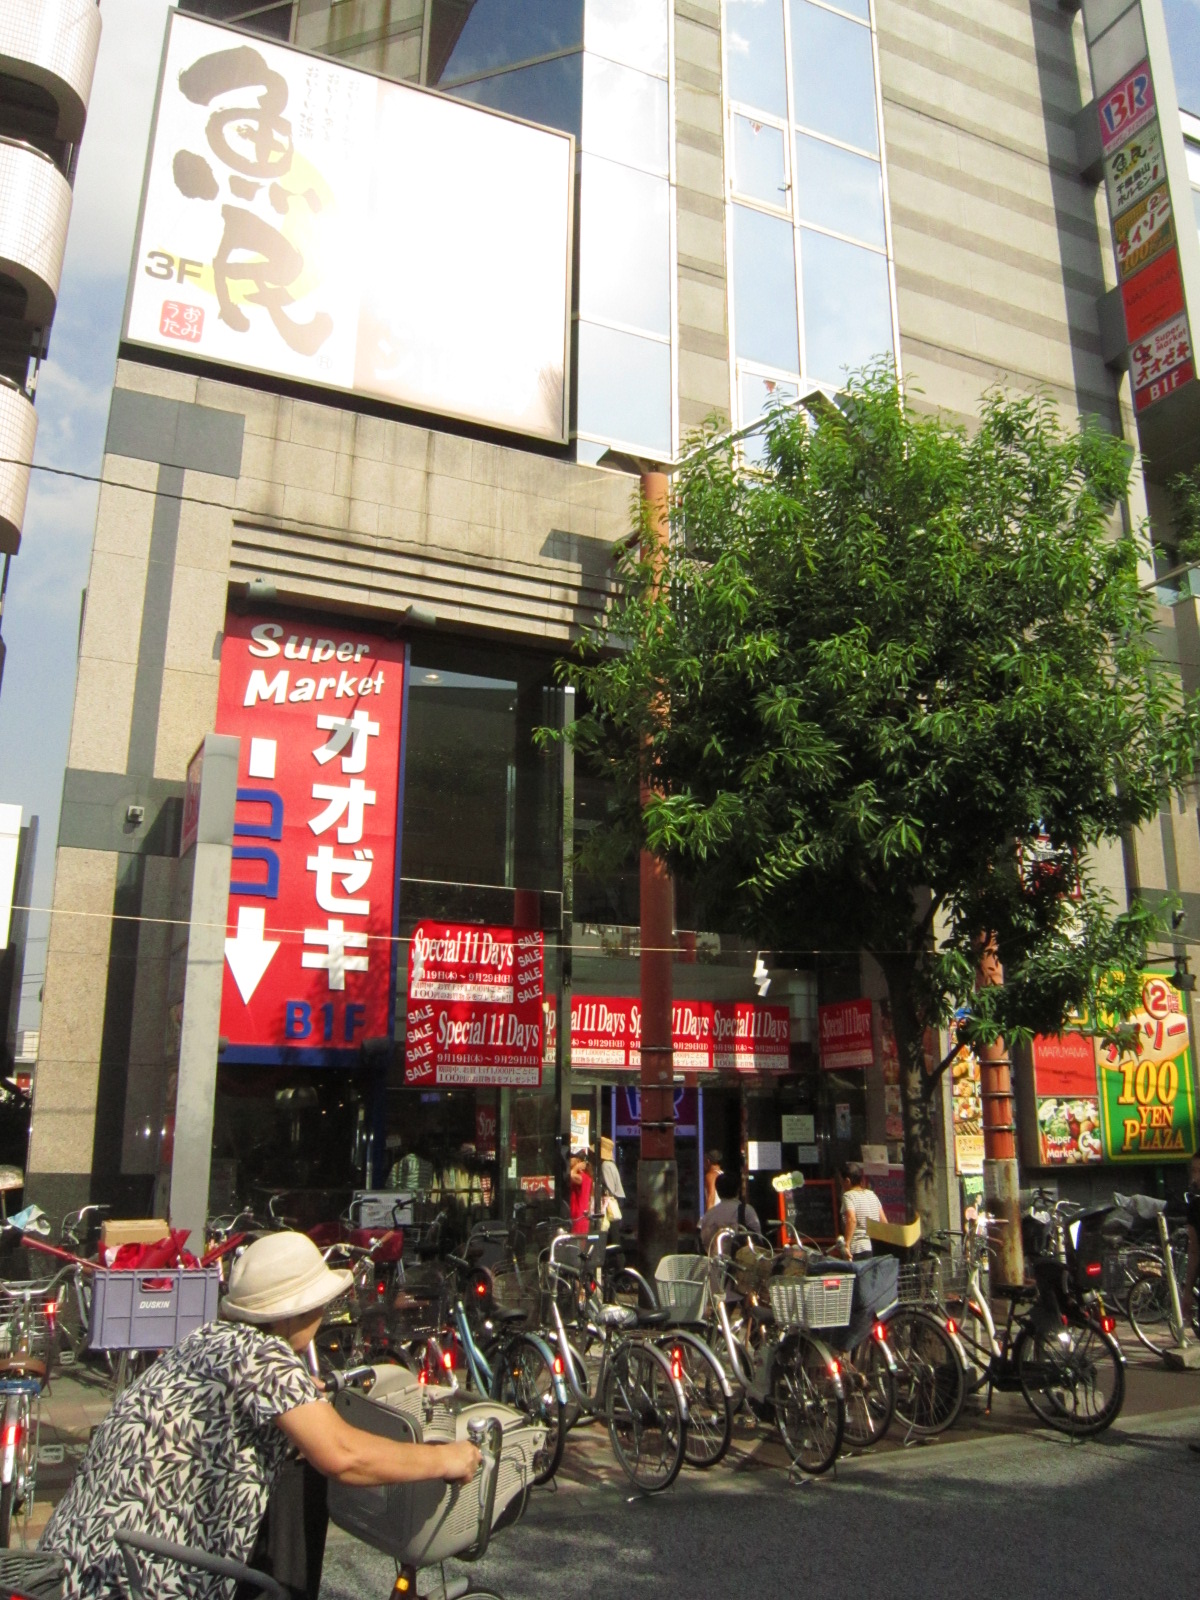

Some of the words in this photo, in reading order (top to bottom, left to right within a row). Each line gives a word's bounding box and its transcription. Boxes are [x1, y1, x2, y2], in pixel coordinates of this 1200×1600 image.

[145, 250, 204, 285] 3F
[1154, 324, 1180, 345] Super
[1155, 329, 1187, 353] Market
[1136, 340, 1189, 387] オオゼキ
[1150, 370, 1180, 401] B1F
[248, 622, 371, 664] Super
[243, 669, 385, 708] Market
[301, 710, 381, 991] オオゼキ
[411, 927, 462, 964] Special
[462, 931, 480, 964] 11
[480, 932, 514, 970] Days
[518, 931, 543, 949] SALE
[518, 949, 543, 967] SALE
[517, 967, 543, 985] SALE
[517, 984, 543, 1003] SALE
[1150, 985, 1168, 1012] 2
[284, 1000, 368, 1043] B1F
[407, 1004, 435, 1024] SALE
[582, 1003, 597, 1032] 11
[597, 1004, 626, 1038] Days
[683, 1007, 710, 1041] Days
[713, 1009, 750, 1041] Special
[750, 1012, 762, 1039] 11
[763, 1011, 789, 1043] Days
[406, 1023, 434, 1043] SALE
[436, 1010, 487, 1050] Special
[487, 1012, 505, 1046] 11
[506, 1013, 539, 1053] Days
[406, 1042, 434, 1062] SALE
[1038, 1046, 1089, 1058] MARUYAMA
[405, 1061, 433, 1081] SALE
[1118, 1060, 1179, 1105] 100
[1138, 1106, 1175, 1128] YEN
[1046, 1134, 1072, 1147] Super
[1122, 1119, 1185, 1151] PLAZA
[1046, 1147, 1077, 1159] Market
[139, 1300, 170, 1309] DUSKIN
